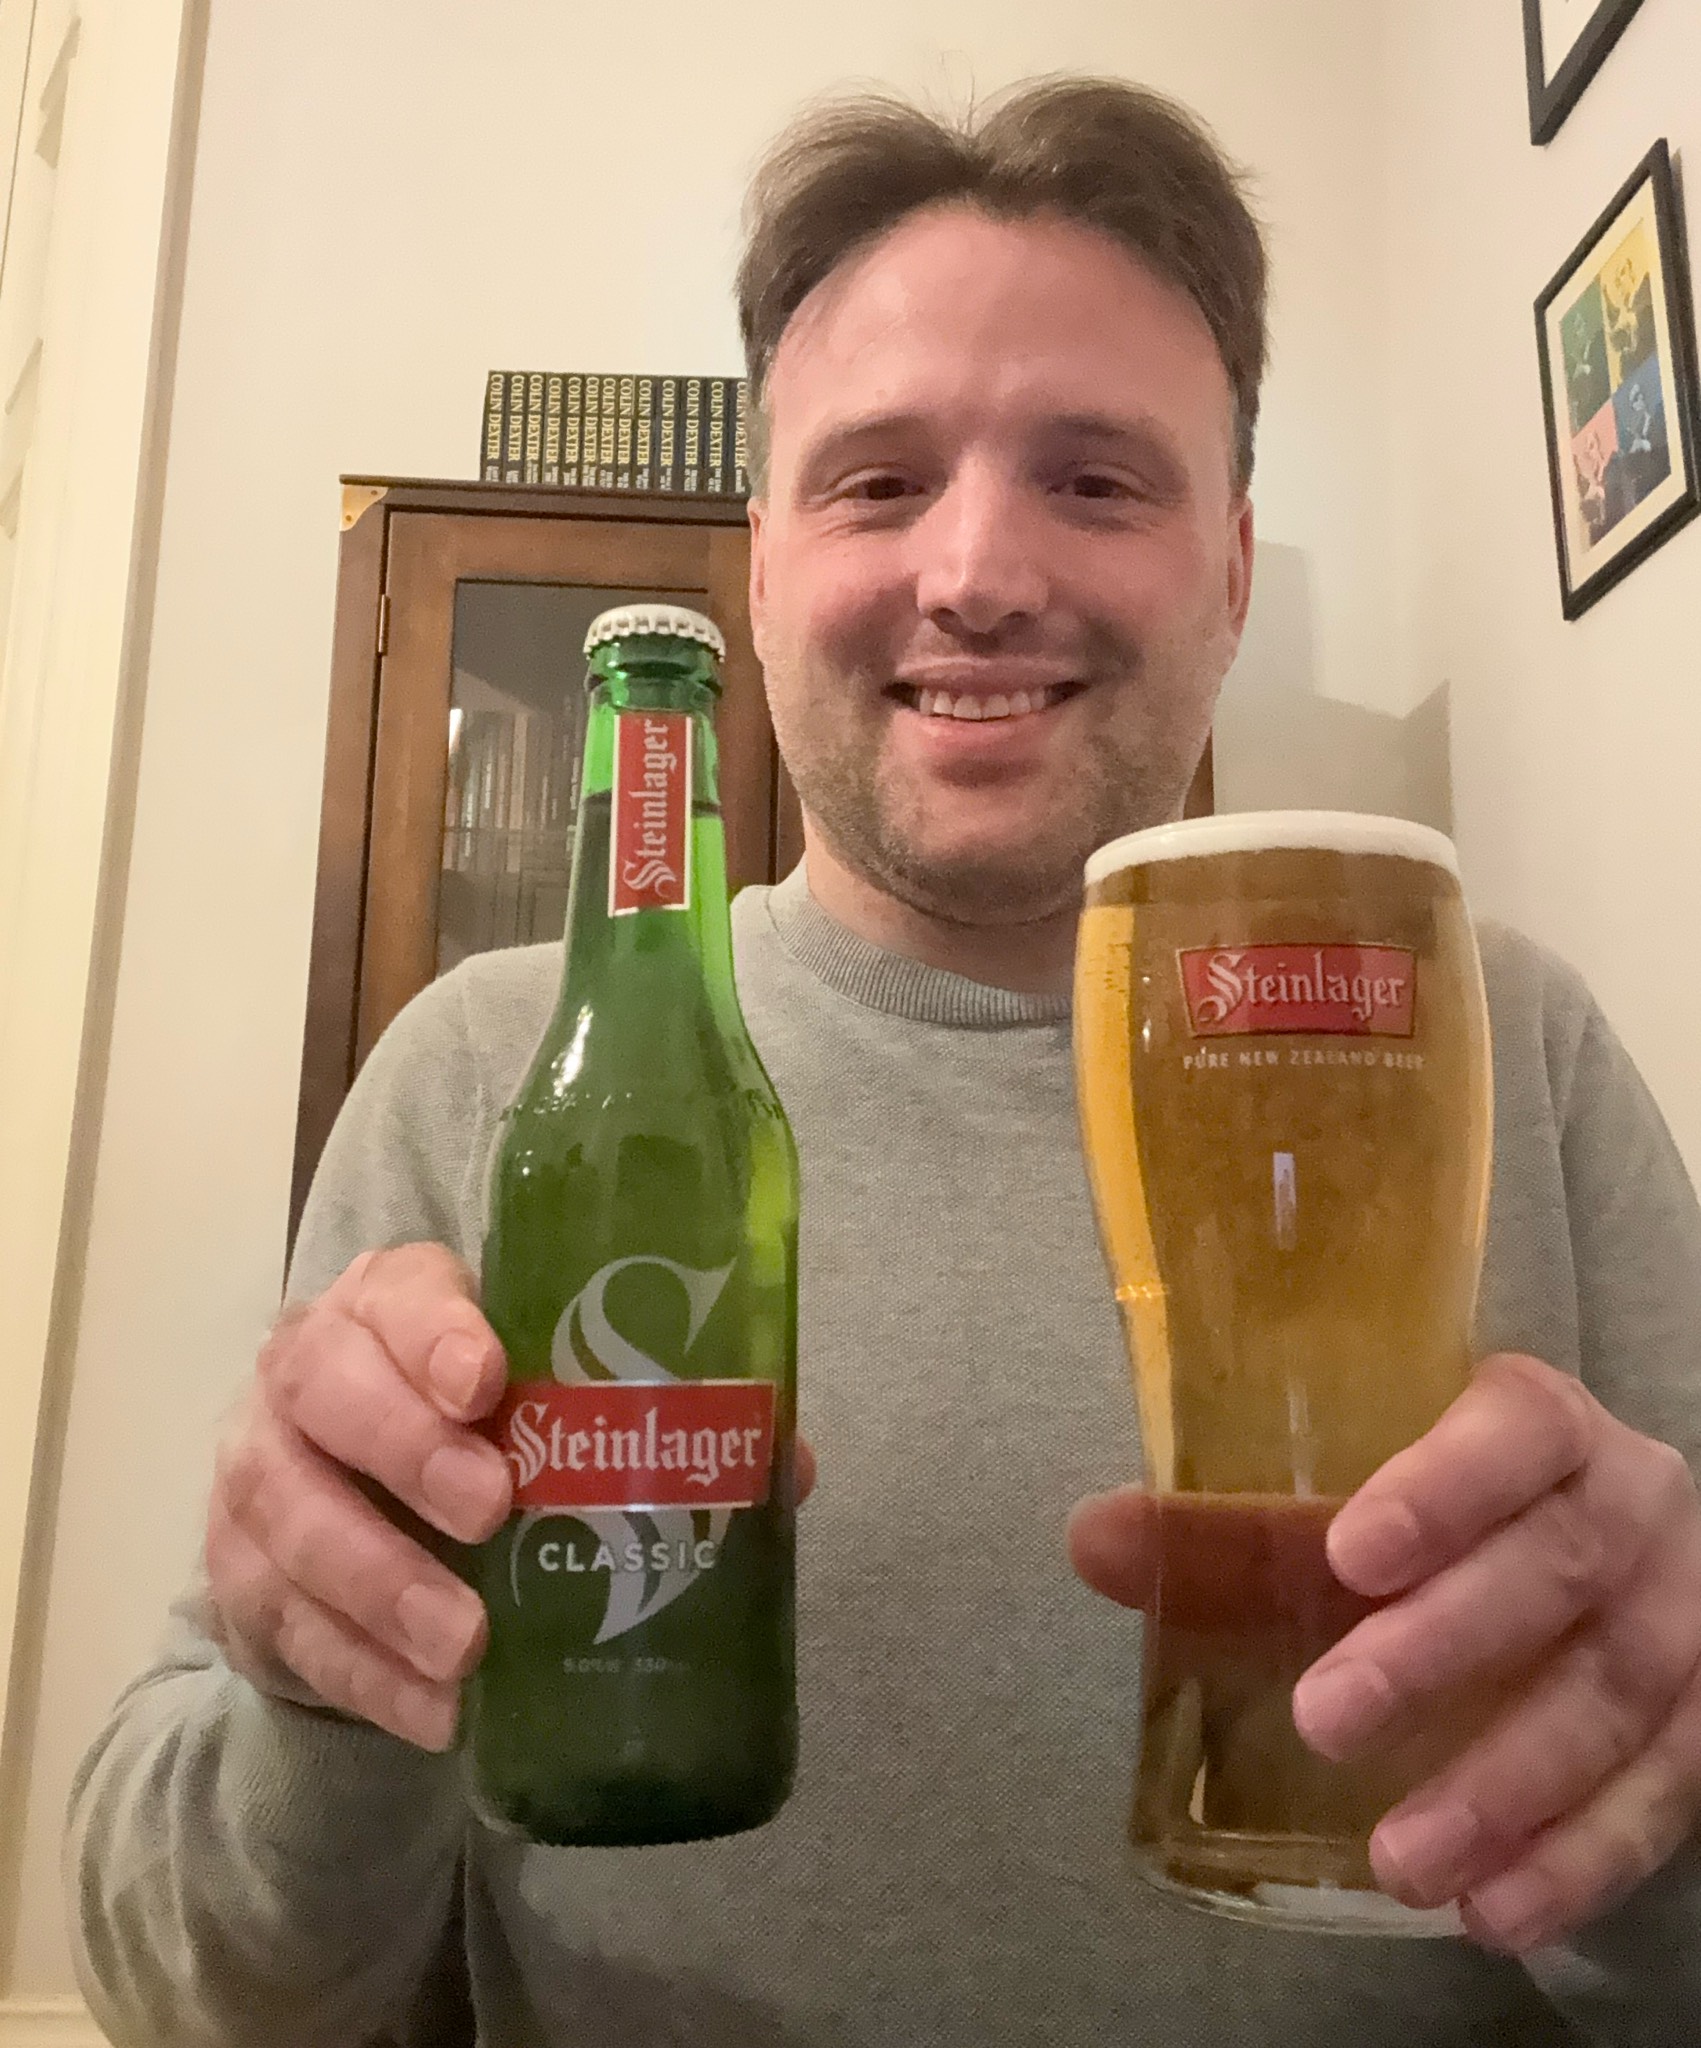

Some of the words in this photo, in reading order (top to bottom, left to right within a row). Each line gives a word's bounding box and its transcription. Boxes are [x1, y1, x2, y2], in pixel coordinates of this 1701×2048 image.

[490, 374, 504, 411] COLIN
[510, 375, 525, 412] COLIN
[529, 374, 543, 411] COLIN
[549, 377, 562, 414] COLIN
[568, 377, 582, 414] COLIN
[585, 377, 599, 414] COLIN
[602, 378, 616, 415] COLIN
[620, 378, 632, 416] COLIN
[639, 380, 652, 416] COLIN
[662, 380, 675, 417] COLIN
[687, 380, 700, 417] COLIN
[711, 381, 724, 418] COLIN
[487, 414, 502, 460] DEXTER
[508, 415, 523, 462] DEXTER
[526, 414, 542, 461] DEXTER
[546, 417, 560, 463] DEXTER
[565, 416, 580, 464] DEXTER
[584, 416, 598, 463] DEXTER
[601, 418, 615, 465] DEXTER
[618, 418, 631, 465] DEXTER
[637, 419, 651, 466] DEXTER
[661, 420, 674, 466] DEXTER
[685, 419, 699, 466] DEXTER
[709, 421, 723, 467] DEXTER
[622, 718, 678, 899] Steinlager
[1197, 950, 1404, 1023] Steinlager
[1183, 1053, 1229, 1070] PURE
[1239, 1051, 1279, 1067] NEW
[1289, 1049, 1377, 1067] ZEALAND
[1382, 1052, 1425, 1071] BEER
[507, 1400, 763, 1489] Steinlager
[537, 1541, 718, 1573] CLASSIC
